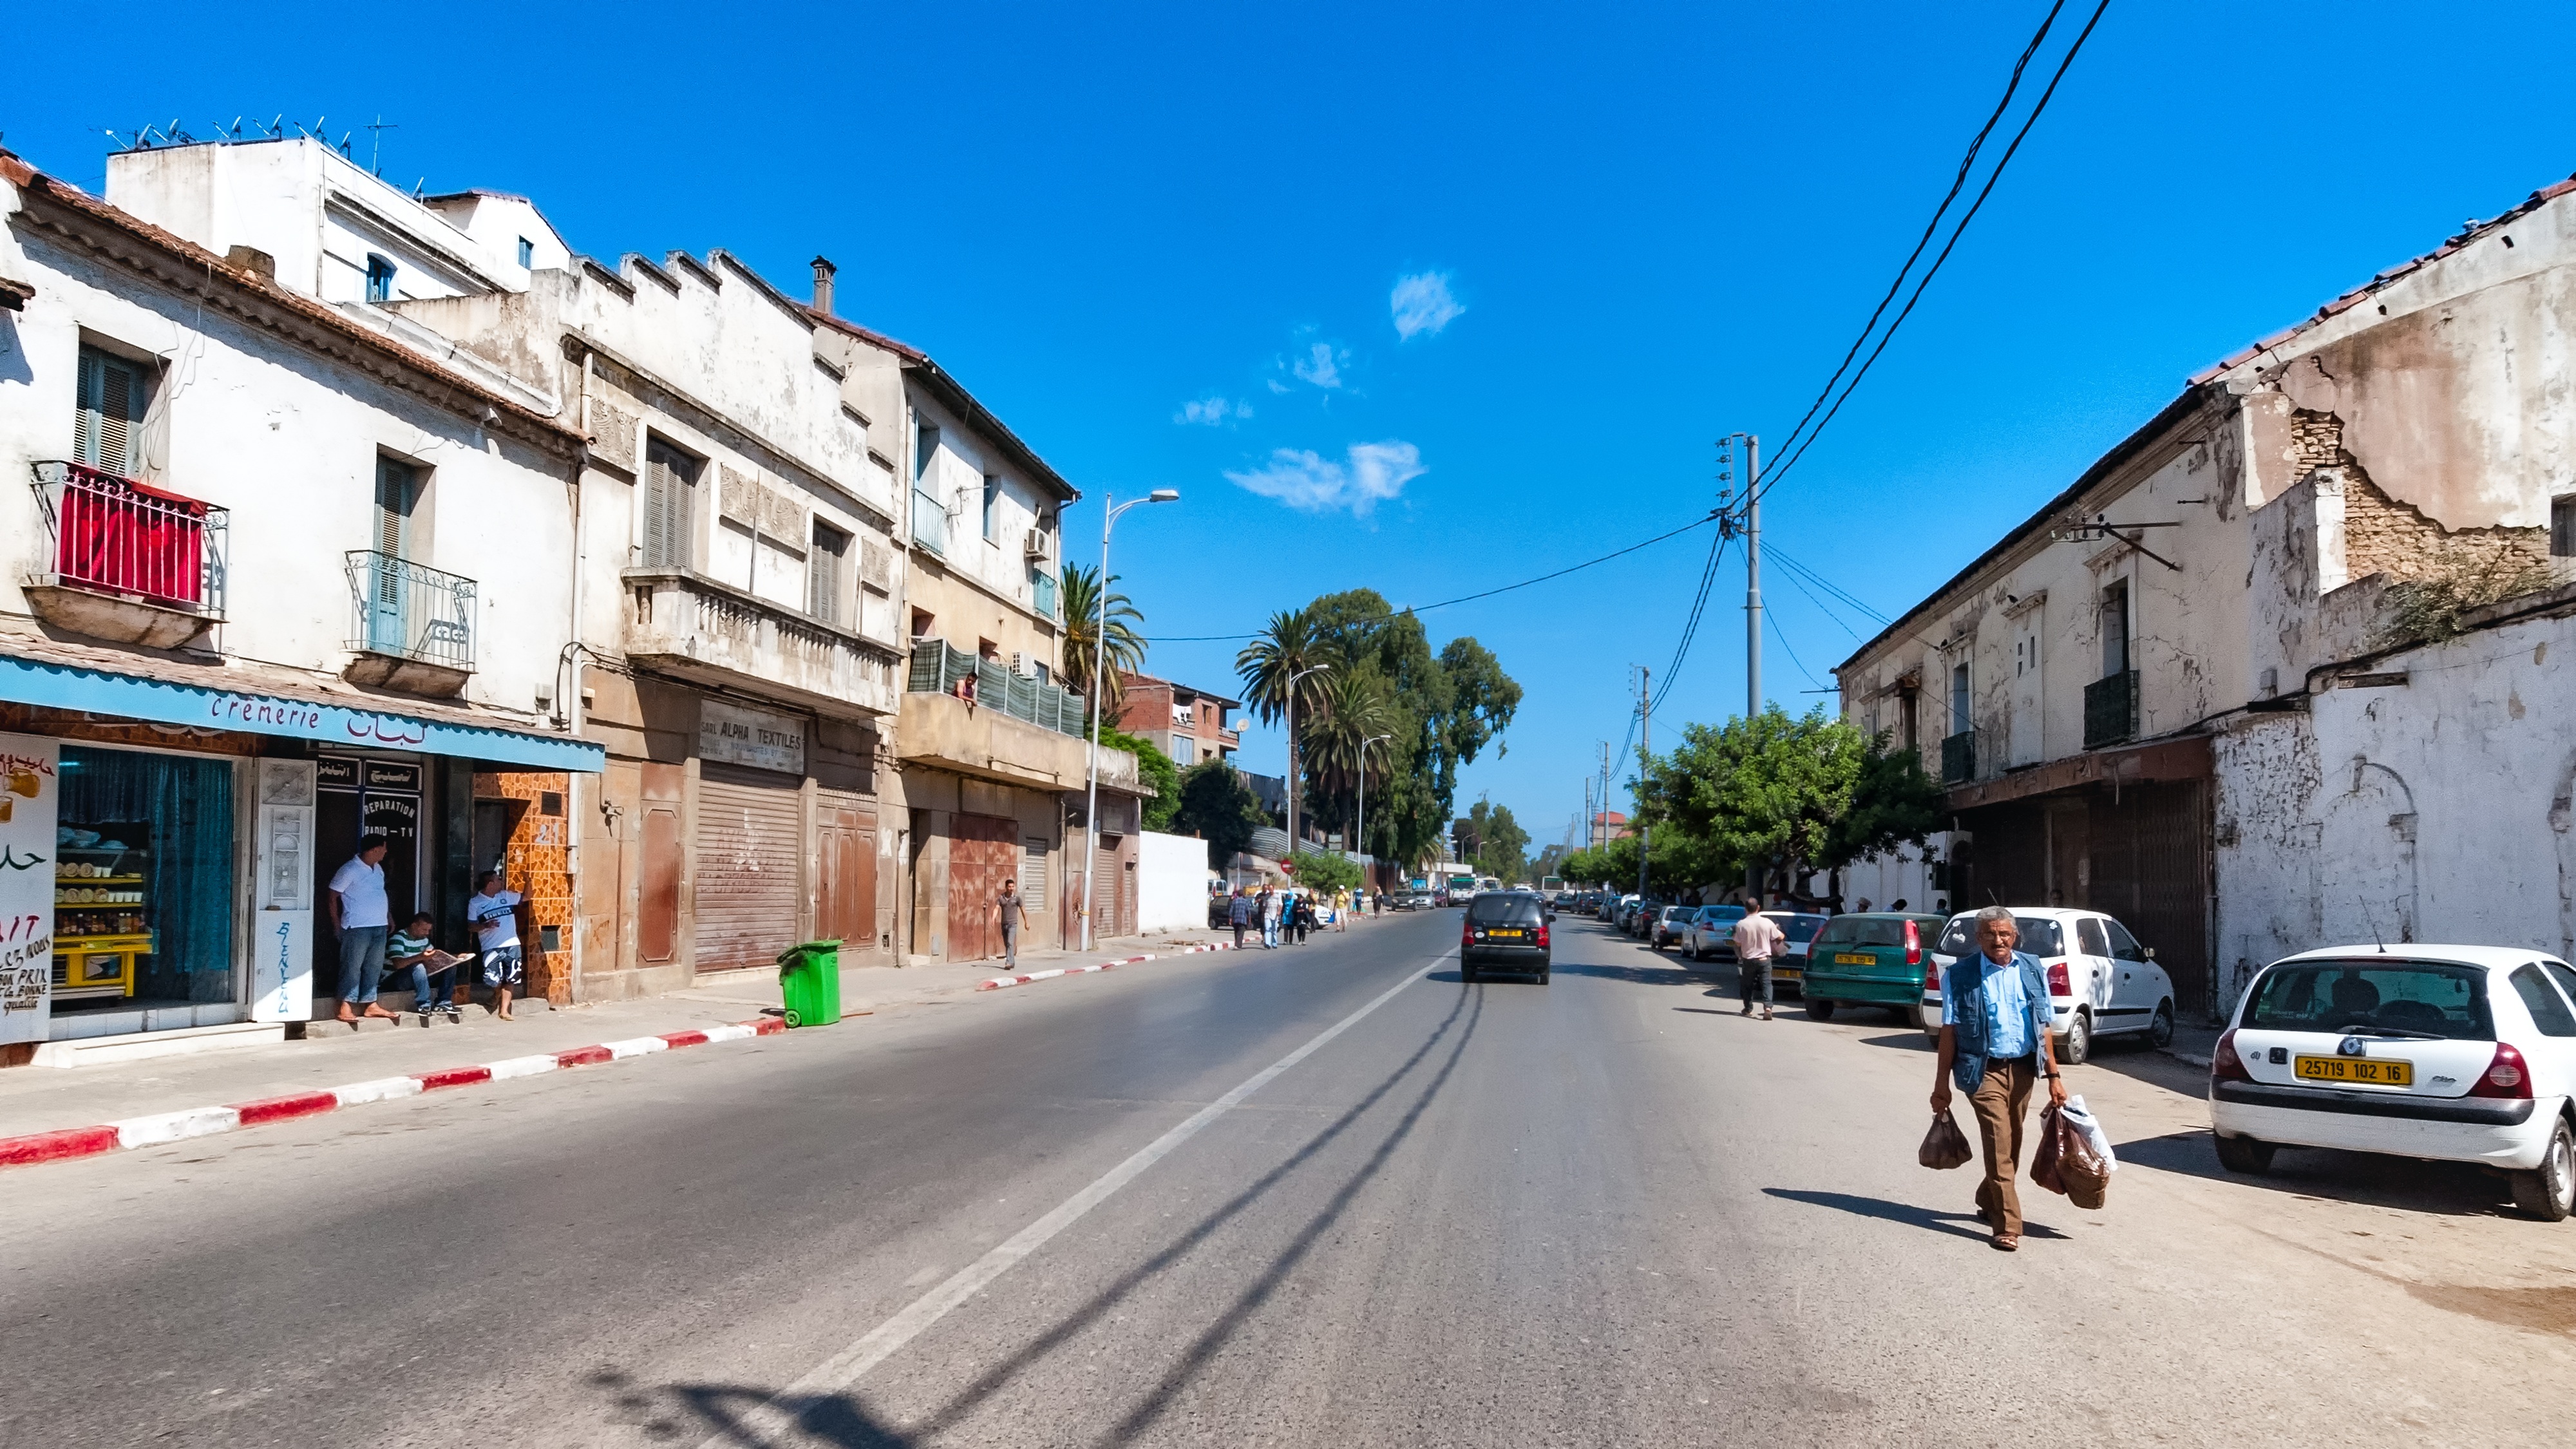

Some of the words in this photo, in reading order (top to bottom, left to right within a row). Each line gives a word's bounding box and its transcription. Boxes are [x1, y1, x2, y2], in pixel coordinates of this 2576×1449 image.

[720, 722, 749, 740] ALPHA
[757, 728, 800, 750] TEXTILES
[363, 800, 416, 819] REPARATION
[364, 826, 388, 837] RADIO
[401, 827, 413, 837] TV
[535, 822, 560, 849] 21
[0, 914, 40, 943] IT
[17, 968, 47, 985] PRIX
[276, 922, 290, 1014] BIENVENU
[2305, 1061, 2345, 1076] 25719
[2354, 1064, 2377, 1079] 102
[2386, 1066, 2401, 1081] 16
